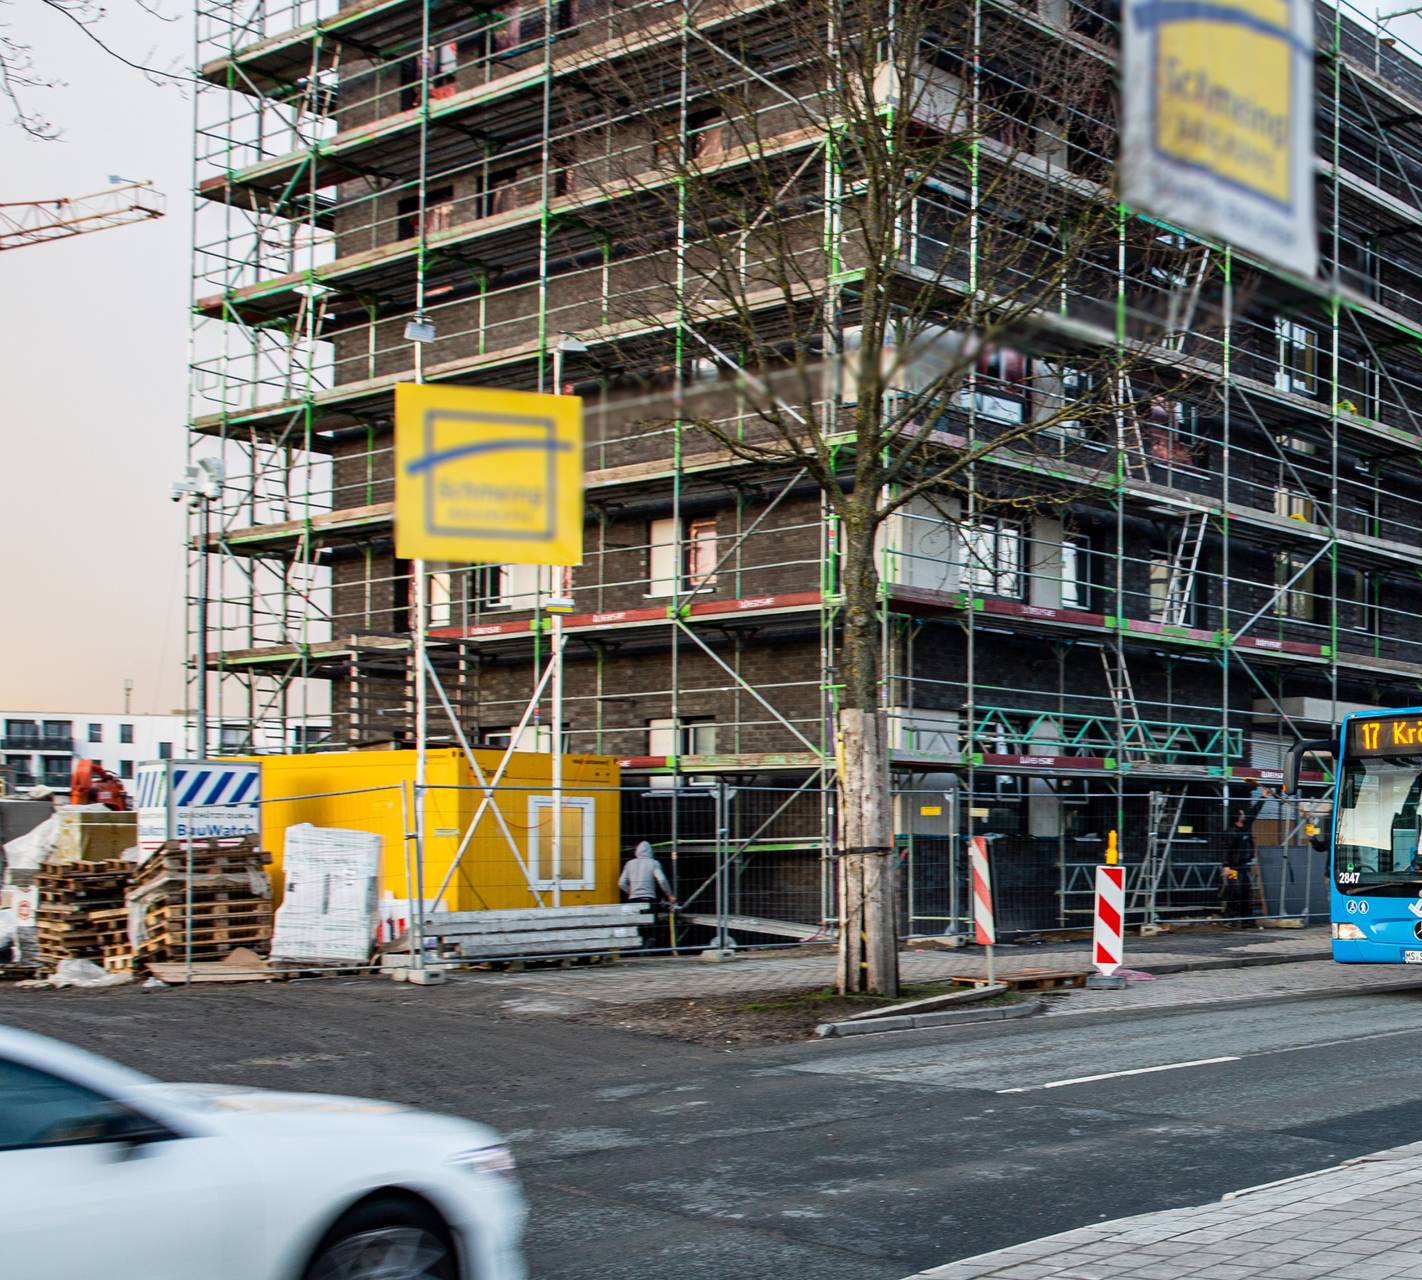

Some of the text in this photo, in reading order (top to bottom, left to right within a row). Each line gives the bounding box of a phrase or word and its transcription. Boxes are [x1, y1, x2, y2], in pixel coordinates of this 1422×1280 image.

[1362, 723, 1380, 750] 17
[176, 824, 254, 836] BauWatch
[1339, 872, 1360, 884] 2847
[1406, 952, 1416, 961] MS
